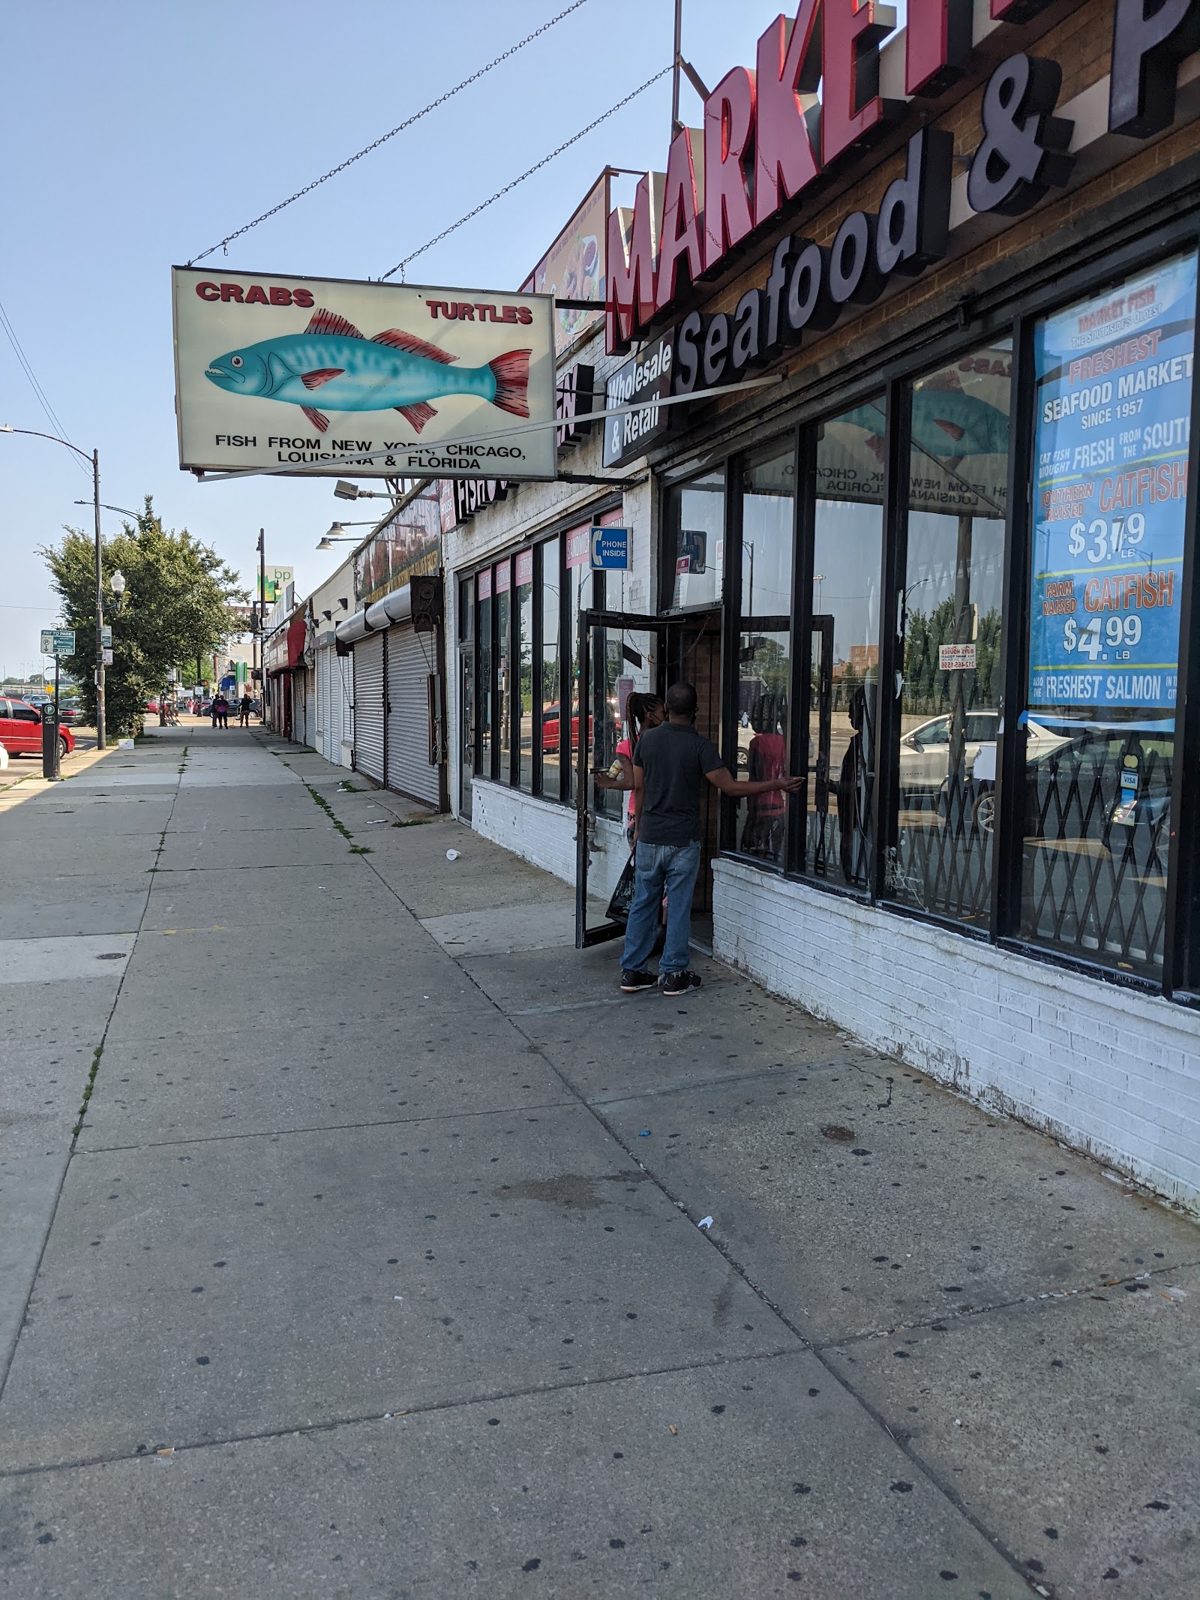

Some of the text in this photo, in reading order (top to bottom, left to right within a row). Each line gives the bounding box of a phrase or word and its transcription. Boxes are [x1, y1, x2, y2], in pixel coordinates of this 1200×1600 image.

[675, 129, 925, 395] Seafood
[967, 52, 1043, 214] &
[195, 281, 315, 308] CRABS
[425, 300, 534, 325] TURTLES
[1068, 329, 1162, 384] FRESHEST
[608, 340, 672, 411] Wholesale
[1043, 353, 1193, 424] SEAFOOD MARKET
[611, 420, 620, 454] &
[623, 390, 660, 447] Retail
[1081, 399, 1144, 430] SINCE 1957
[215, 434, 257, 447] FISH
[268, 437, 321, 450] FROM
[332, 440, 372, 451] NEW
[446, 444, 526, 460] CHICAGO,
[1119, 428, 1141, 444] FROM
[385, 456, 397, 466] &
[408, 456, 481, 469] FLORIDA
[1053, 448, 1070, 461] FISH
[1072, 437, 1115, 470] FRESH
[1123, 446, 1136, 458] THE
[1043, 481, 1095, 507] OUTHERN
[1100, 461, 1188, 512] CATFISH
[601, 540, 627, 549] PHONE
[1121, 549, 1135, 558] LB
[274, 569, 291, 581] bp
[1046, 580, 1073, 598] FARM
[1084, 570, 1174, 613] CATFISH
[1043, 598, 1077, 616] RAISED
[1063, 615, 1142, 661] $4.99
[1115, 651, 1130, 660] LB
[1046, 675, 1102, 698] FRESHEST
[1106, 675, 1161, 700] SALMON
[1124, 776, 1136, 784] VISA
